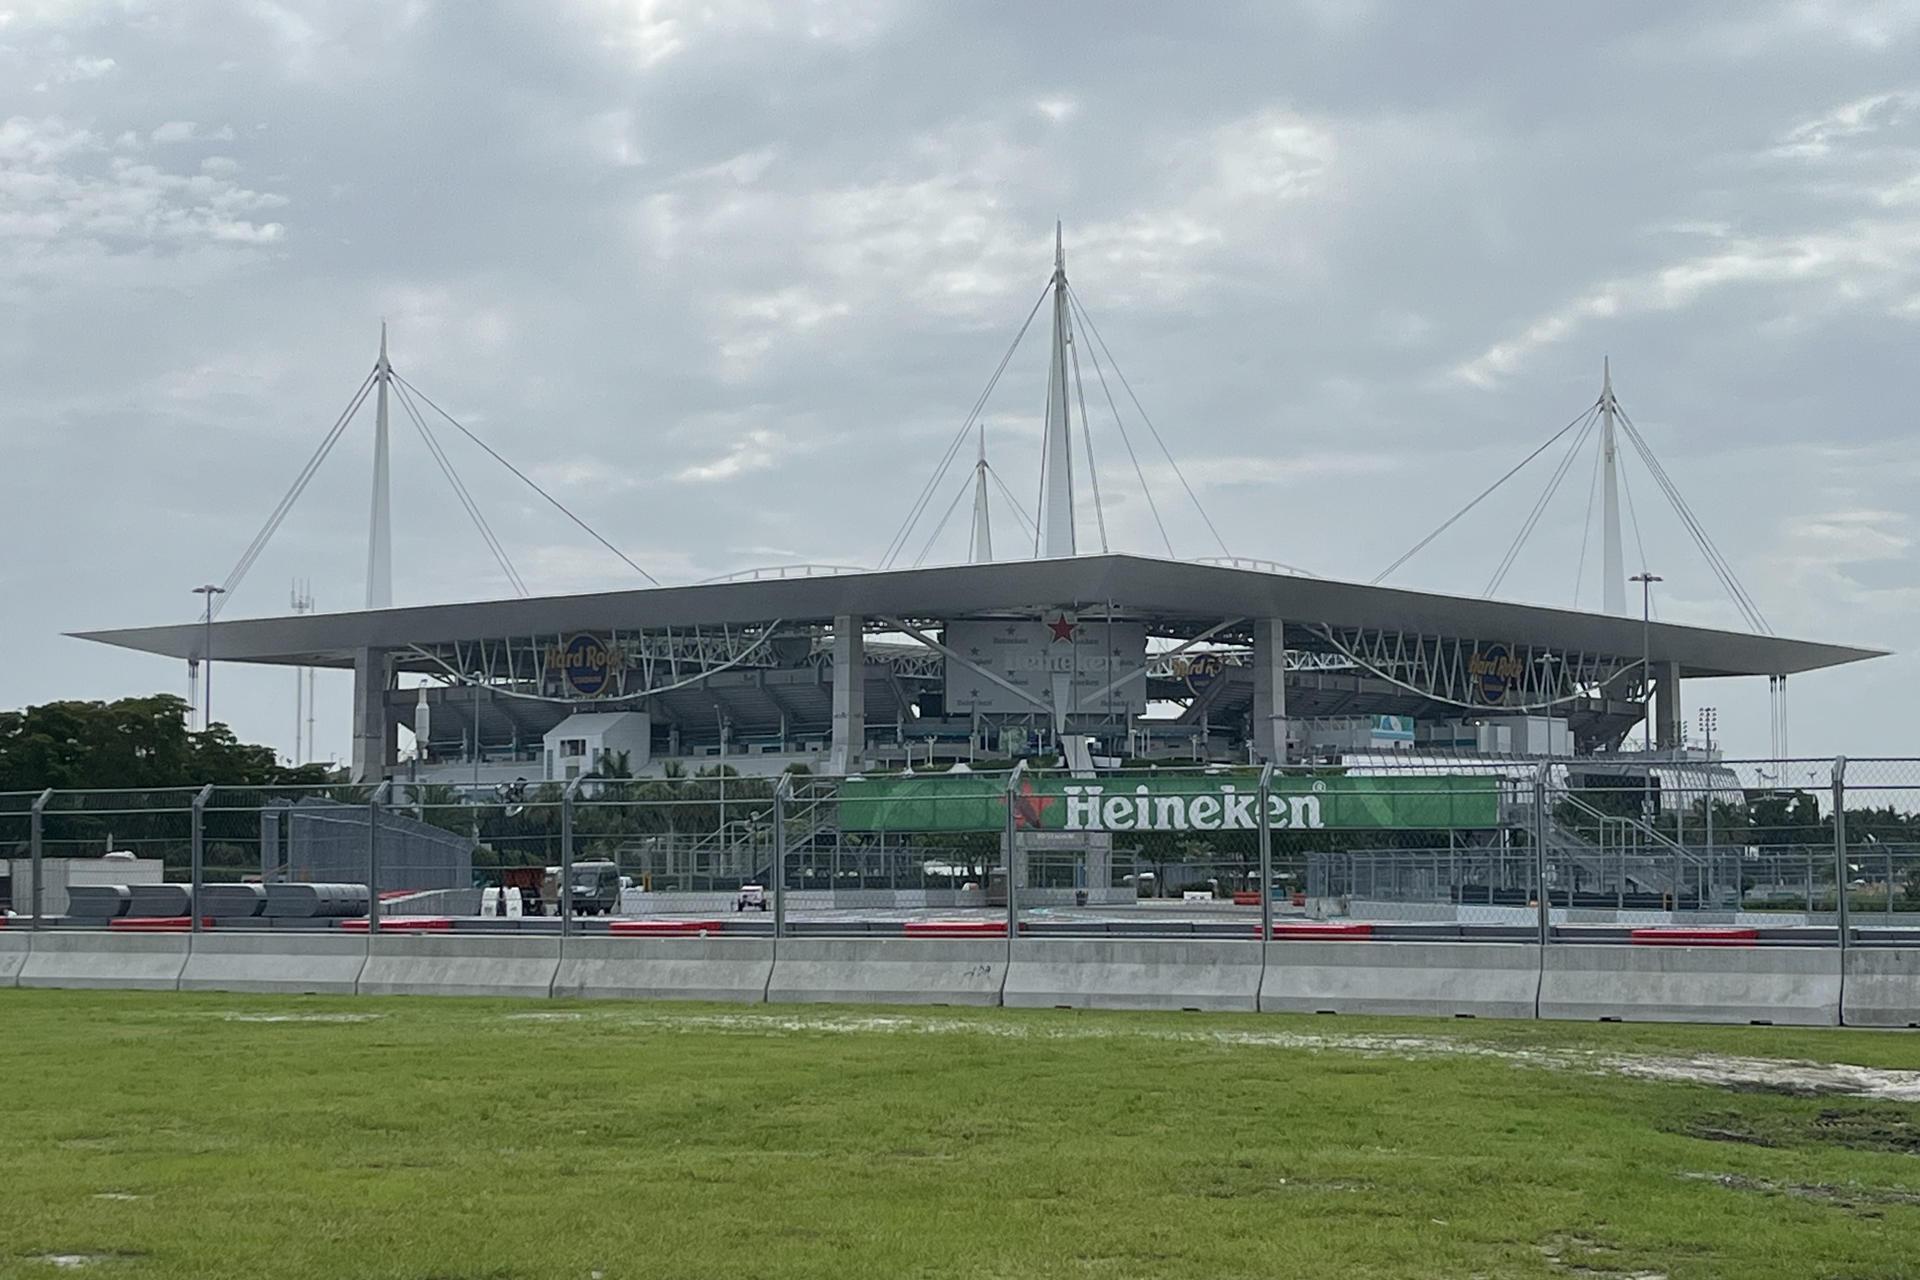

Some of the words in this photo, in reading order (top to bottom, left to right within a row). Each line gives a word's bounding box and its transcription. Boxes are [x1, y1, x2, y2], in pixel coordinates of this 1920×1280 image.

[545, 643, 583, 668] Hard
[1468, 652, 1498, 676] Hard
[1064, 784, 1325, 830] Heineken
